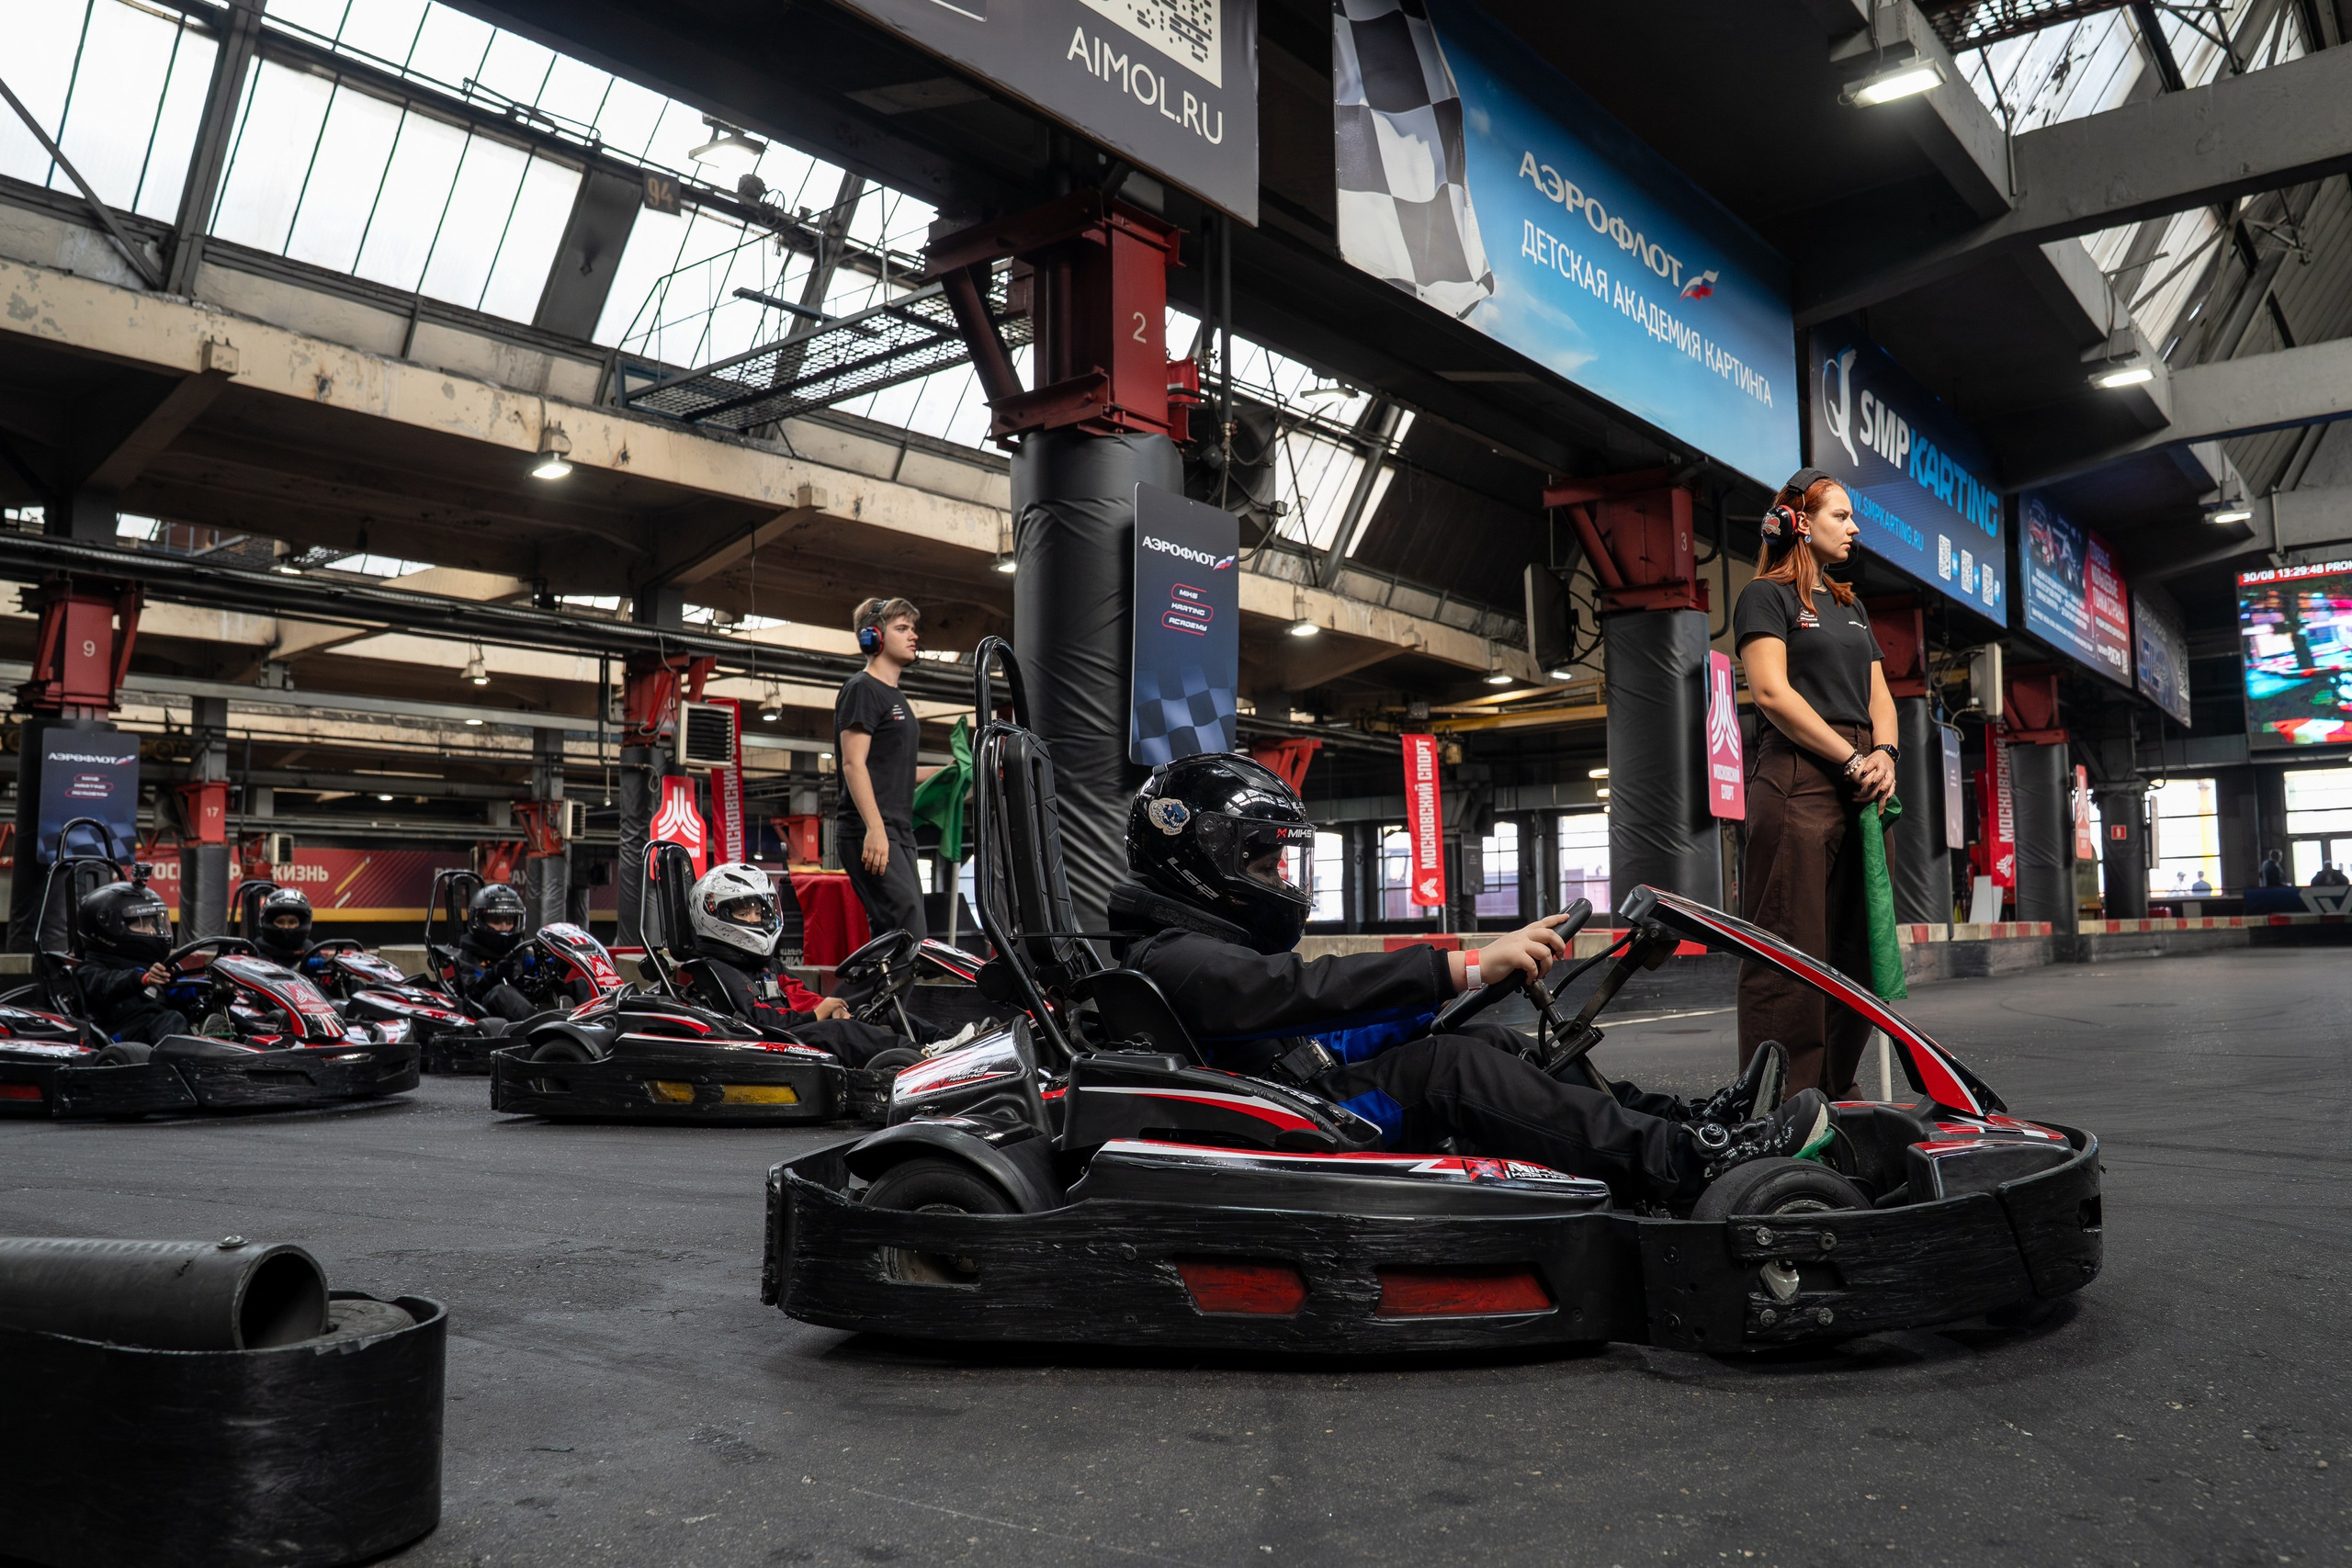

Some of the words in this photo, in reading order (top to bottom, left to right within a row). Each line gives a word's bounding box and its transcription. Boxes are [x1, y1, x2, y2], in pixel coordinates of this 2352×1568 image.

[1067, 26, 1224, 146] AIMOL.RU
[1519, 150, 1683, 288] АЭРОФЛОТ
[1132, 310, 1148, 344] 2
[1521, 219, 1609, 303] ДЕТСКАЯ
[1613, 280, 1702, 363] АКАДЕМИЯ
[1705, 338, 1773, 409] КАРТИНГА
[1836, 478, 1925, 553] WW.SMPKARTING.RU
[1142, 535, 1216, 569] АЭРОФЛОТ
[1680, 531, 1689, 552] 3
[1168, 616, 1208, 632] ACADEMY
[1170, 602, 1206, 616] KARTING
[82, 640, 96, 658] 9
[48, 751, 118, 765] АЭРОФЛОТ
[1415, 739, 1434, 781] СПОРТ
[206, 806, 220, 818] 17
[722, 755, 742, 864] МОСКОВСКИ
[1414, 783, 1438, 870] МОСКОВСКИЙ
[1287, 829, 1312, 839] MIKS
